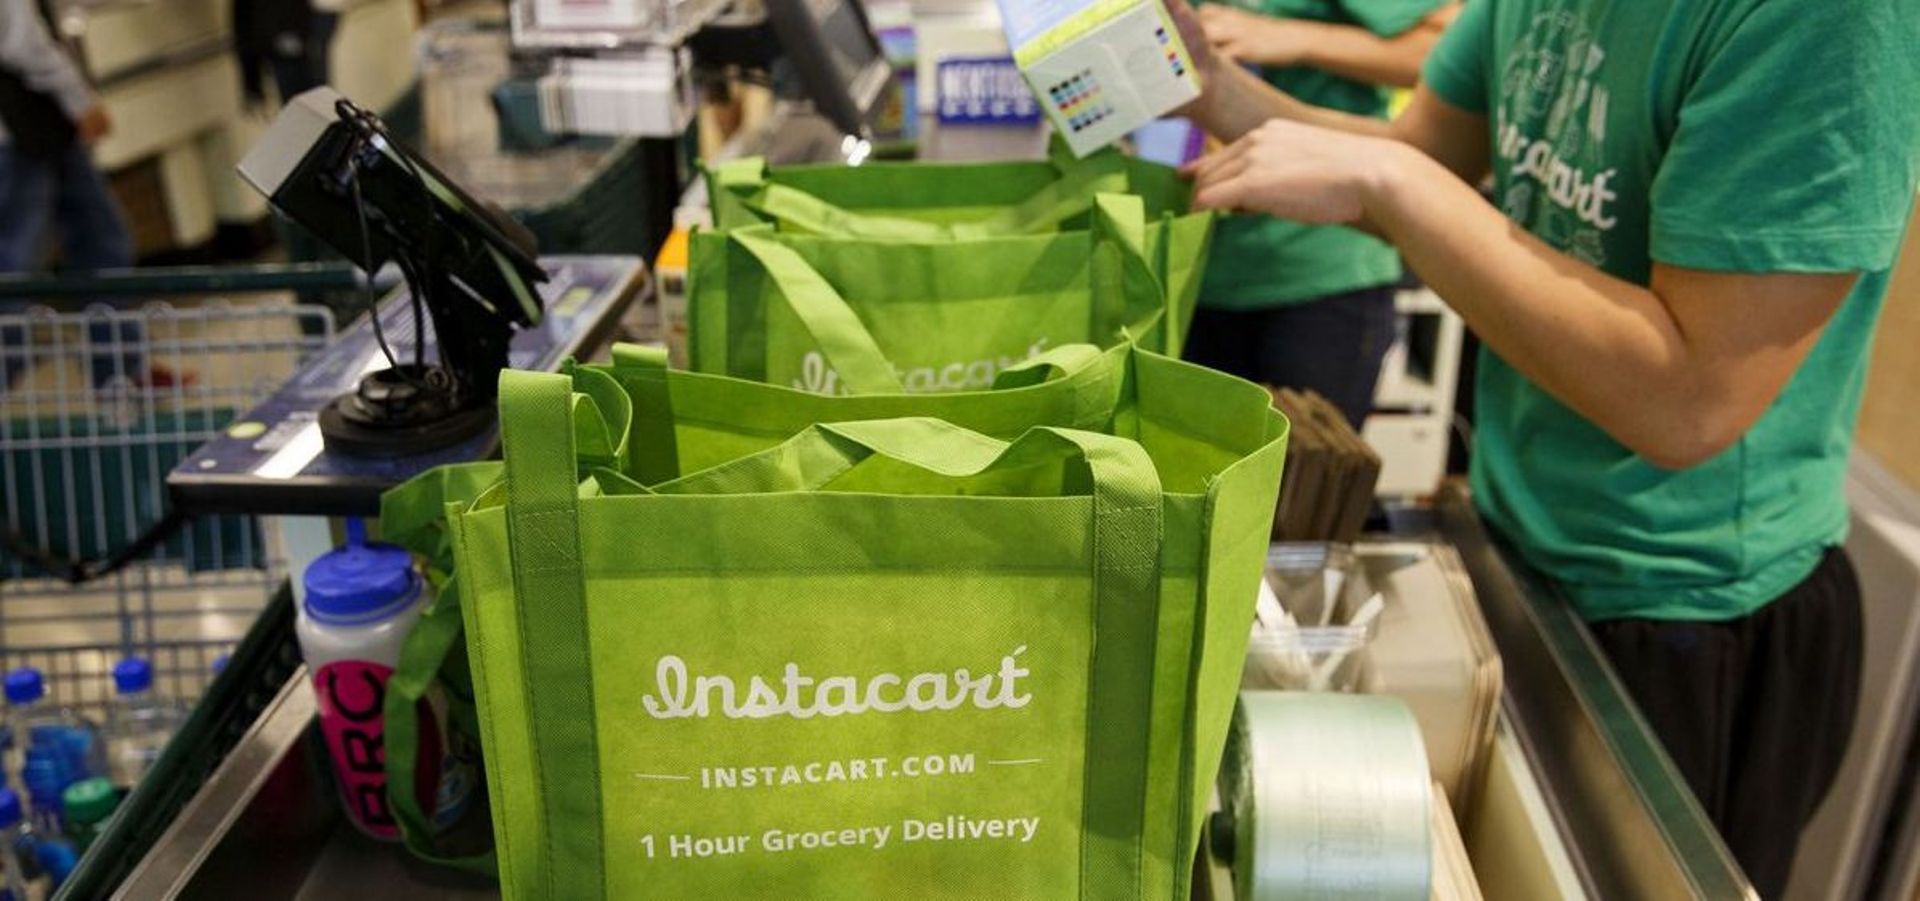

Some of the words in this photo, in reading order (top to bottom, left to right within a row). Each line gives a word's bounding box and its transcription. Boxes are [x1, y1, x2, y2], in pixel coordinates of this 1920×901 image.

[642, 645, 1031, 718] Instacart
[701, 754, 976, 788] INSTACART.COM
[641, 834, 654, 858] 1
[670, 833, 750, 858] Hour
[762, 826, 891, 850] Grocery
[903, 815, 1040, 842] Delivery
